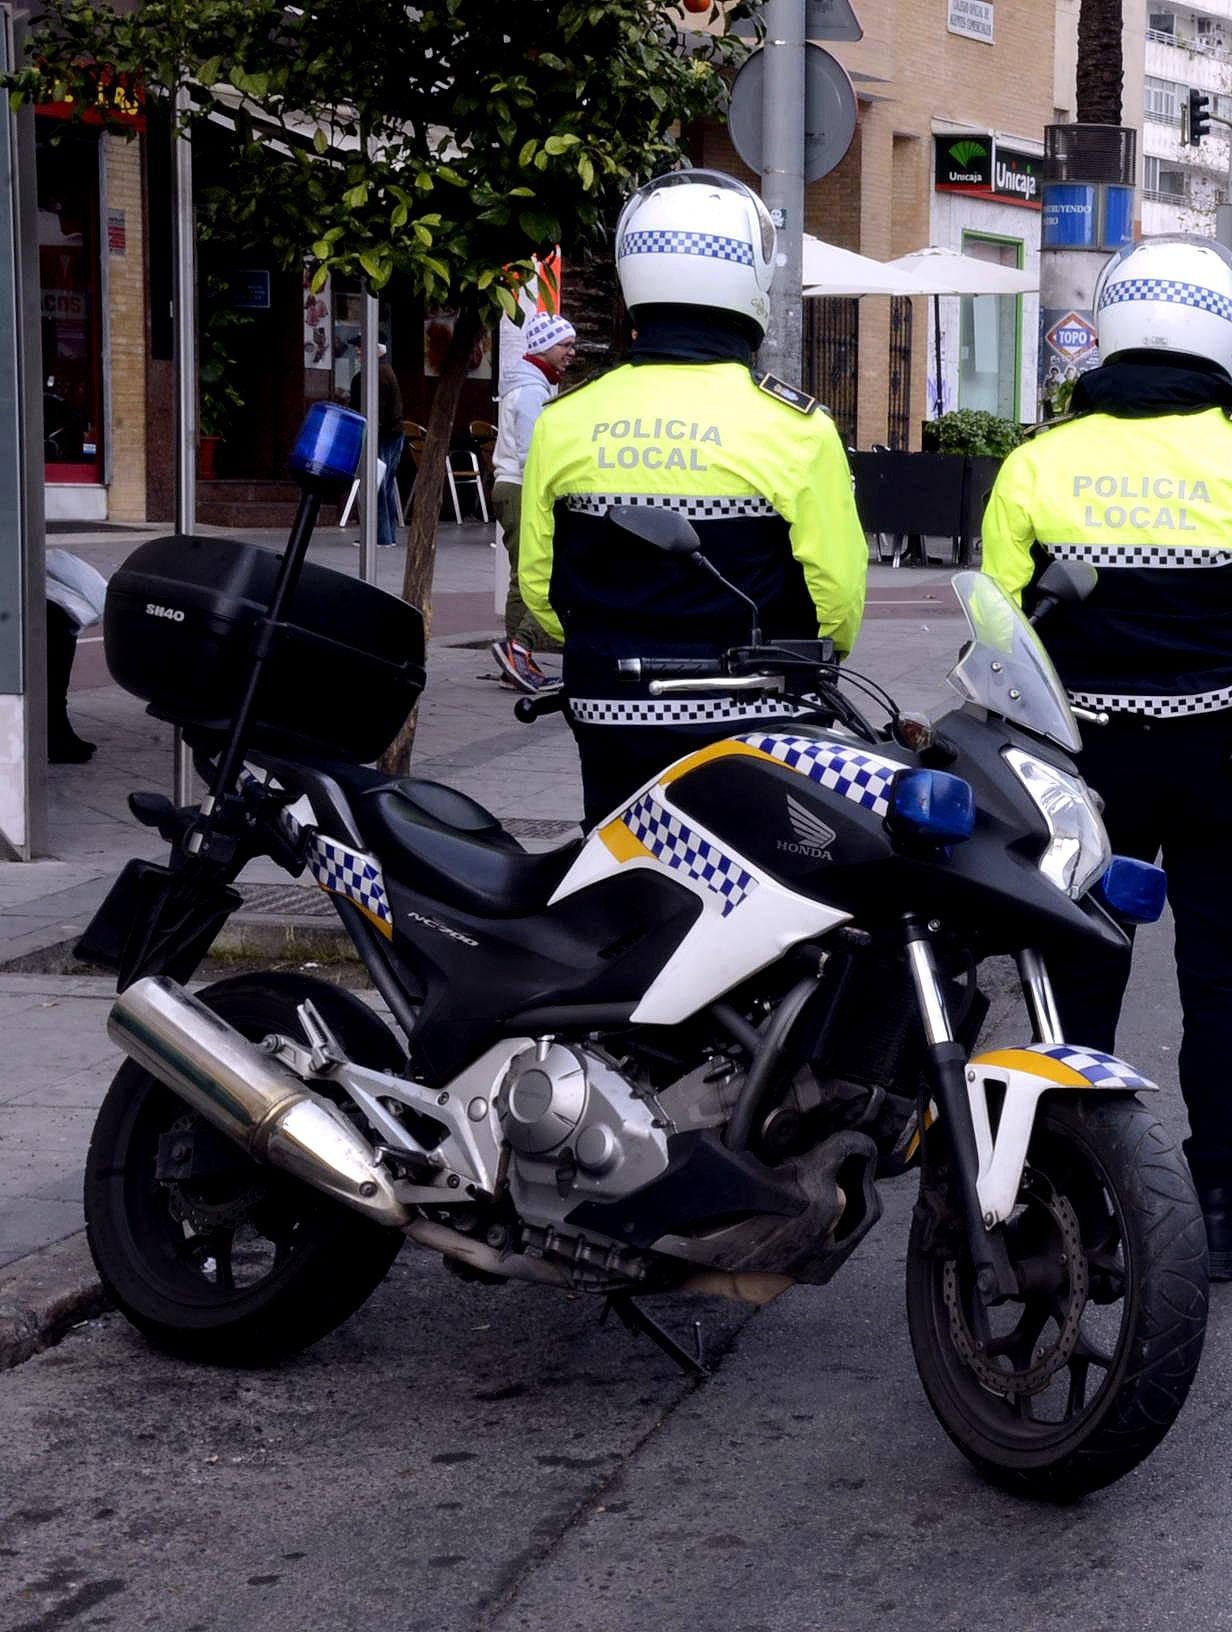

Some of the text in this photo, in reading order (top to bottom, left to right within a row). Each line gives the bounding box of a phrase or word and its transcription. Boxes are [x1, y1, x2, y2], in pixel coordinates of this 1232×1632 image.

[948, 171, 982, 183] Unicaja
[996, 160, 1036, 200] Unicaja
[1058, 330, 1088, 345] TOPO
[592, 418, 722, 447] POLICIA
[598, 446, 708, 471] LOCAL
[1073, 475, 1212, 503] POLICIA
[1085, 505, 1197, 530] LOCAL
[145, 603, 185, 622] SH40
[776, 840, 833, 861] HONDA
